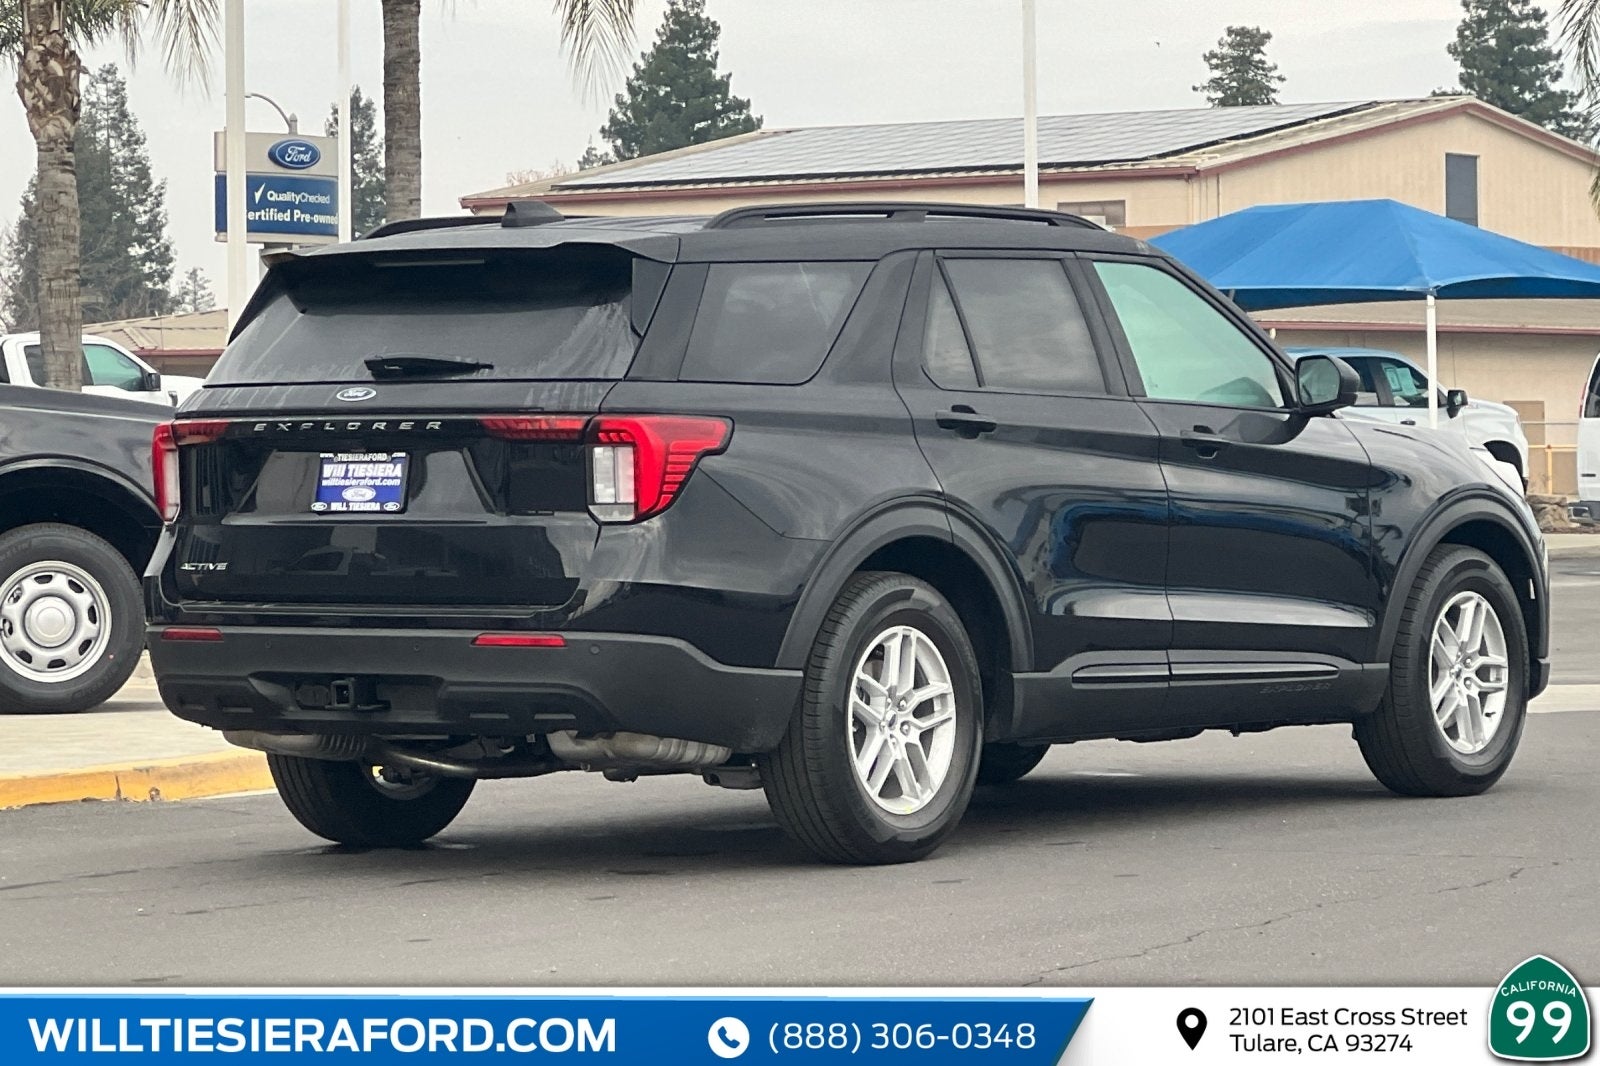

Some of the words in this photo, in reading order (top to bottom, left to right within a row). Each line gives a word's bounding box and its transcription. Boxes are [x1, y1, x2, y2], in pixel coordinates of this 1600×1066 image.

[285, 145, 312, 162] Ford
[266, 190, 331, 204] QualityChecked
[246, 207, 291, 221] ertified
[253, 421, 442, 432] EXPLORER
[347, 463, 402, 478] TIESIERA
[321, 478, 401, 487] willtiesieraford.com
[180, 562, 228, 571] ACTIVE
